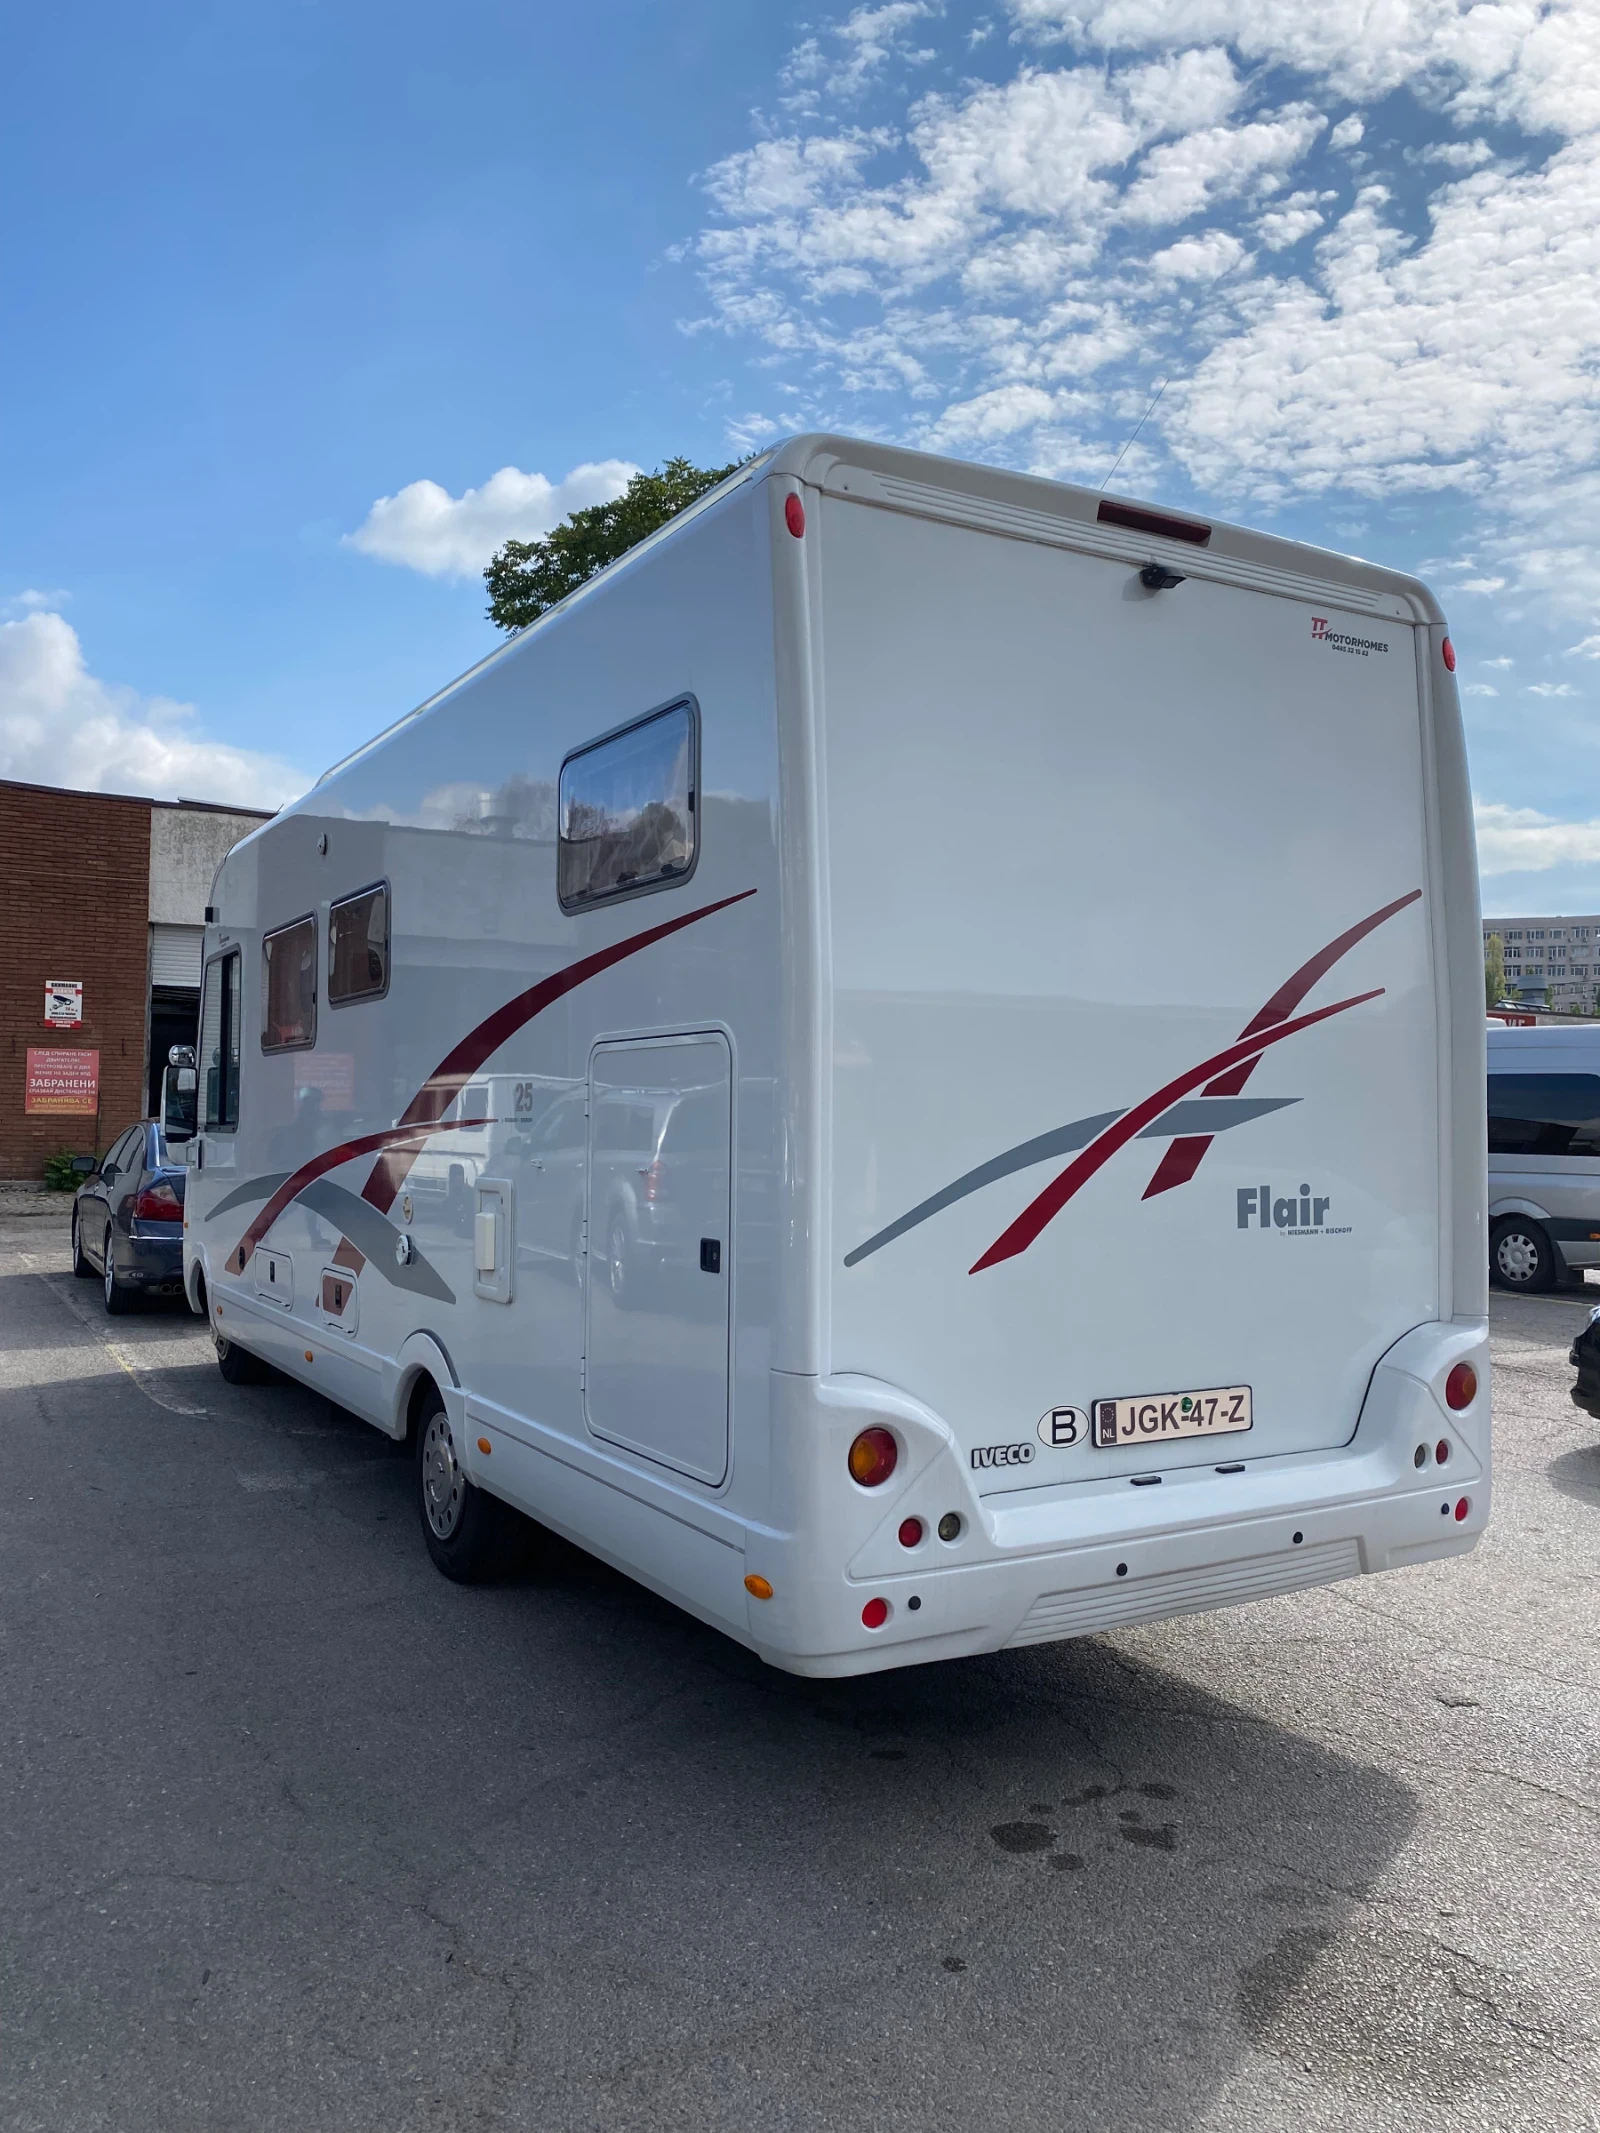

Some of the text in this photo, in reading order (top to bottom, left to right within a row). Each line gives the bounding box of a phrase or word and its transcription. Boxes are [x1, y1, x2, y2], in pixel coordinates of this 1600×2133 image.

[1325, 632, 1389, 653] MOTORHOMES
[29, 1078, 96, 1088] ЗАБРАНЕНИ
[515, 1082, 533, 1112] 25
[1237, 1183, 1330, 1229] Flair
[1287, 1228, 1319, 1236] NIESMANN
[1052, 1410, 1078, 1445] B
[1121, 1394, 1245, 1437] JGK-47-Z
[1102, 1427, 1115, 1439] NL
[971, 1442, 1036, 1469] IVECO
